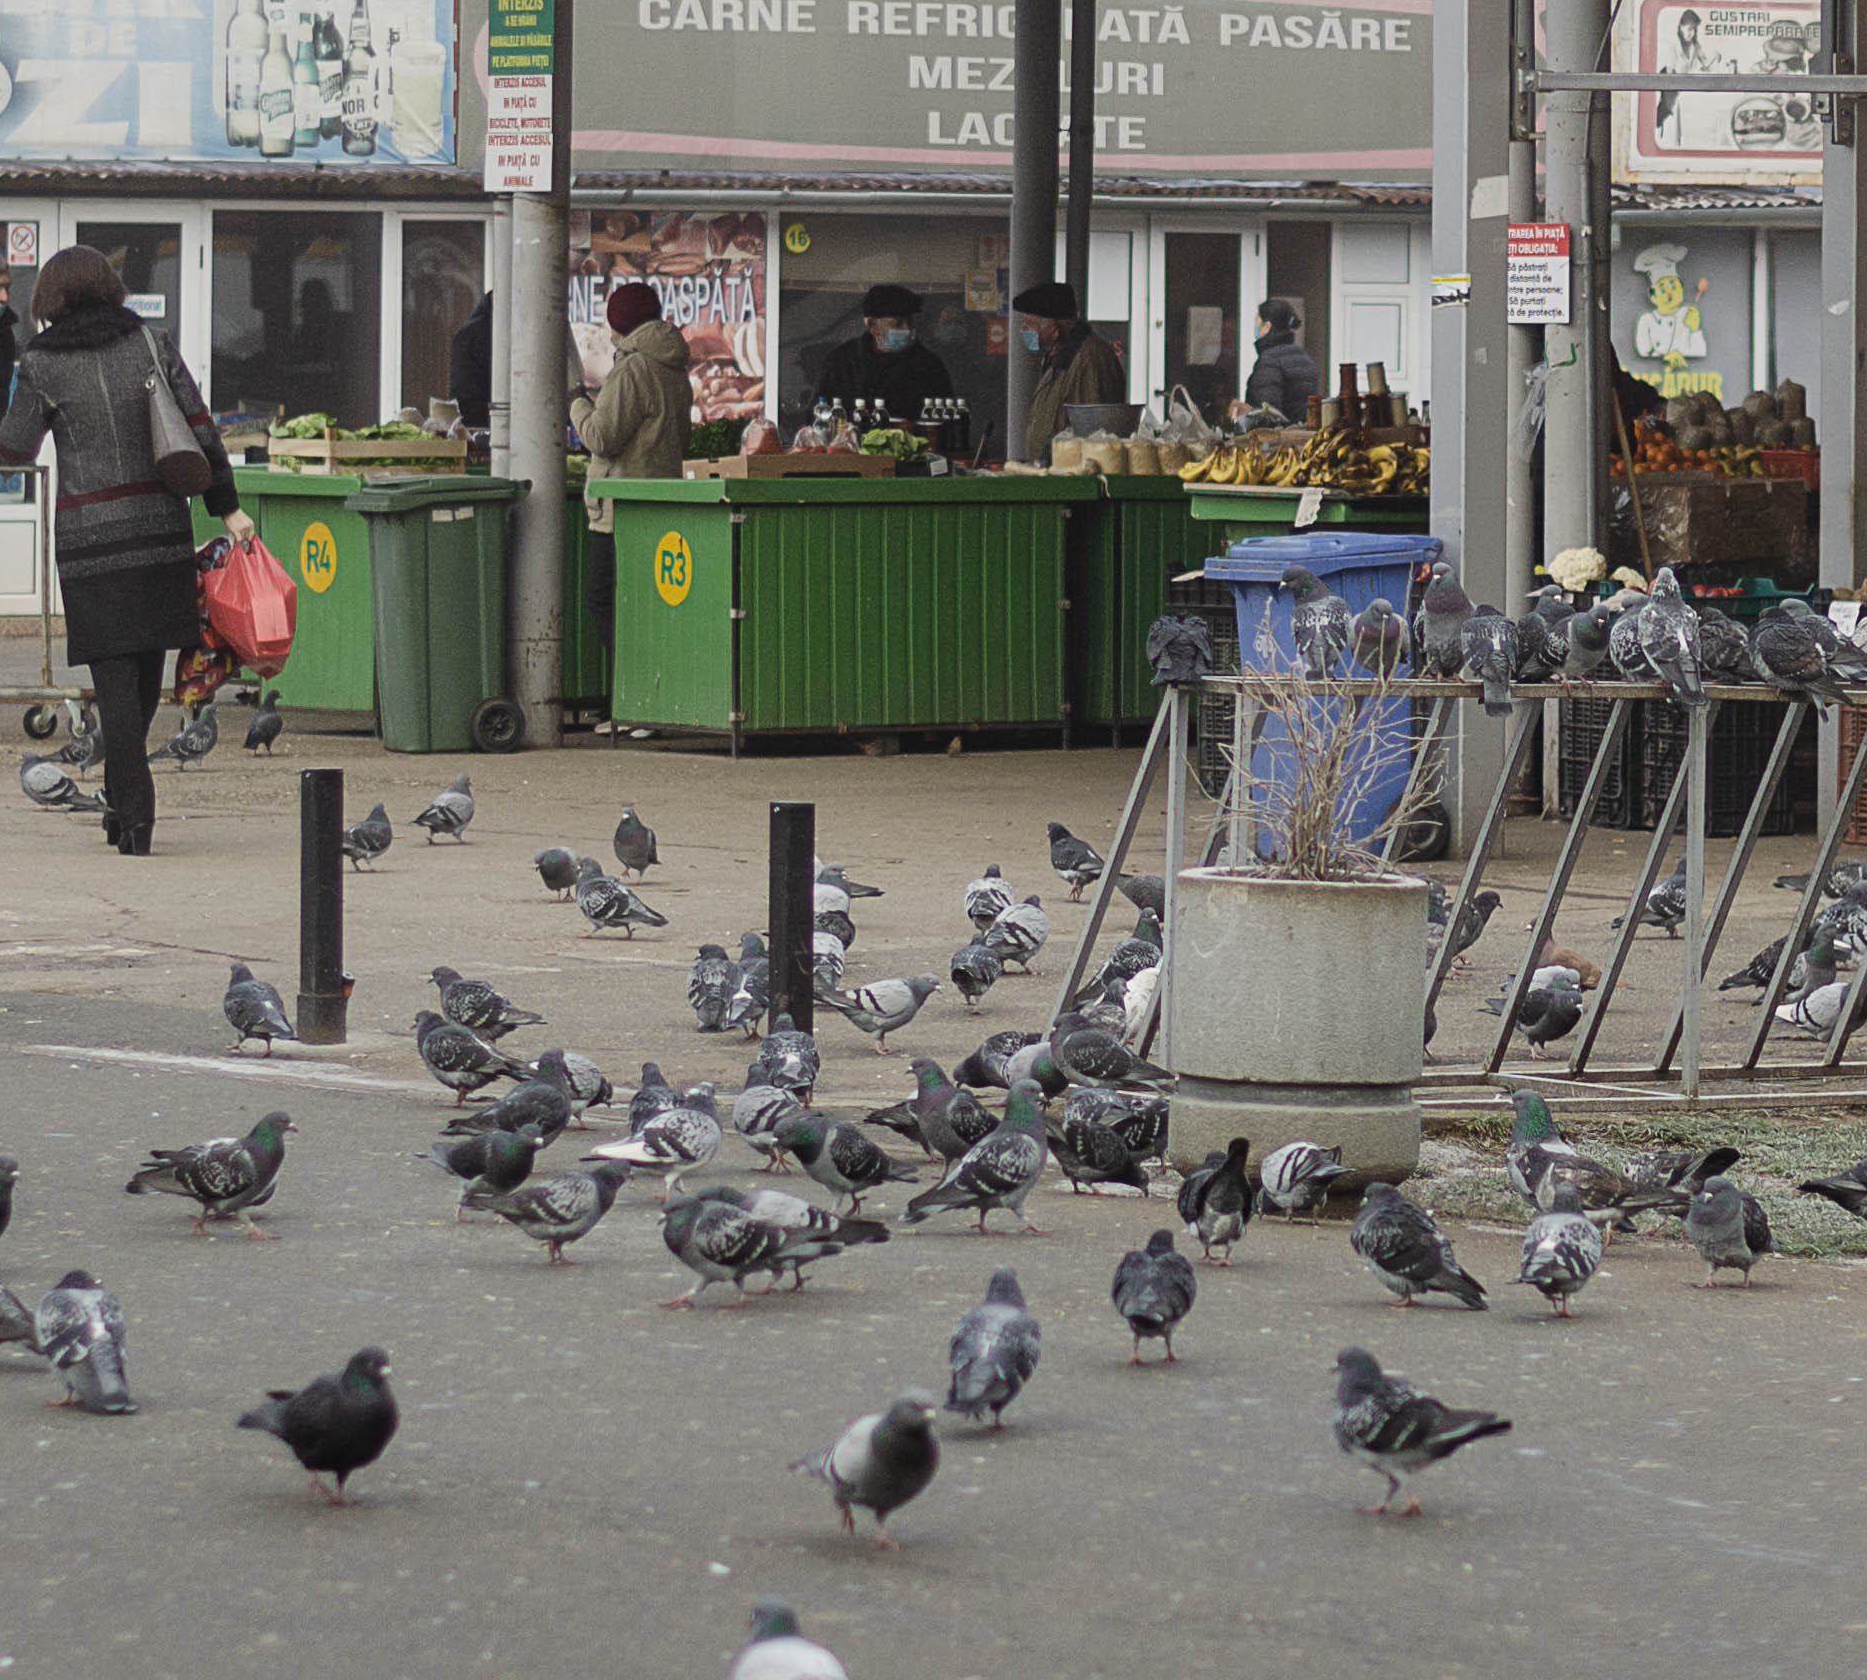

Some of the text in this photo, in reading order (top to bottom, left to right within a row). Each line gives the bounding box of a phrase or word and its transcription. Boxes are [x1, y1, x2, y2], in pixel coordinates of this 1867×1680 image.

[68, 21, 137, 55] DE
[847, 0, 1190, 45] REFRIGATĂ
[1219, 10, 1412, 52] PASĂRE
[909, 55, 1164, 96] MEZLURI
[4, 59, 195, 146] ZI
[488, 135, 551, 146] INTERZIS ACCESUL
[928, 111, 1146, 150] LACTE
[530, 155, 540, 167] CU
[307, 540, 331, 573] R4
[661, 550, 686, 587] R3
